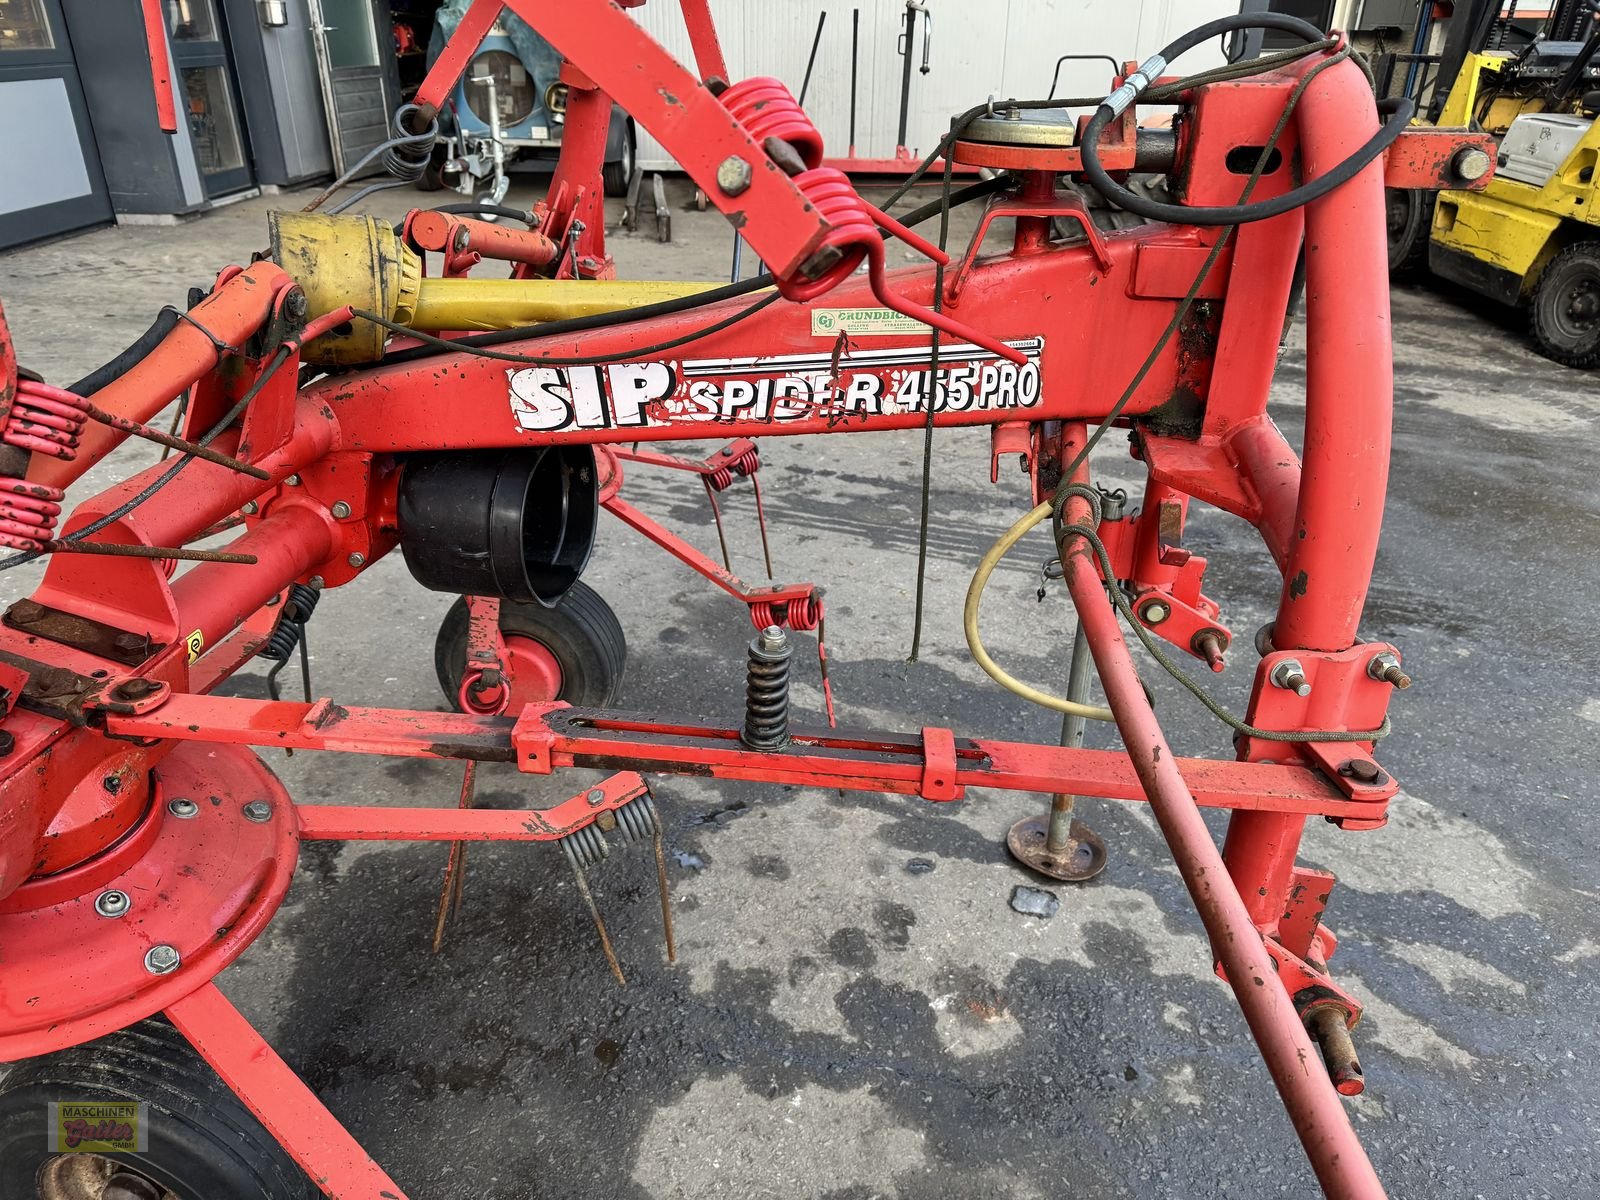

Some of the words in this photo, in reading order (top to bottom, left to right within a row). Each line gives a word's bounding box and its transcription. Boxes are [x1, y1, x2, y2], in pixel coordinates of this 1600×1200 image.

[838, 311, 912, 321] GRUNDBIC
[509, 361, 678, 431] SIP
[688, 373, 883, 421] SPIDER
[896, 368, 976, 412] 455
[978, 361, 1041, 409] PRO
